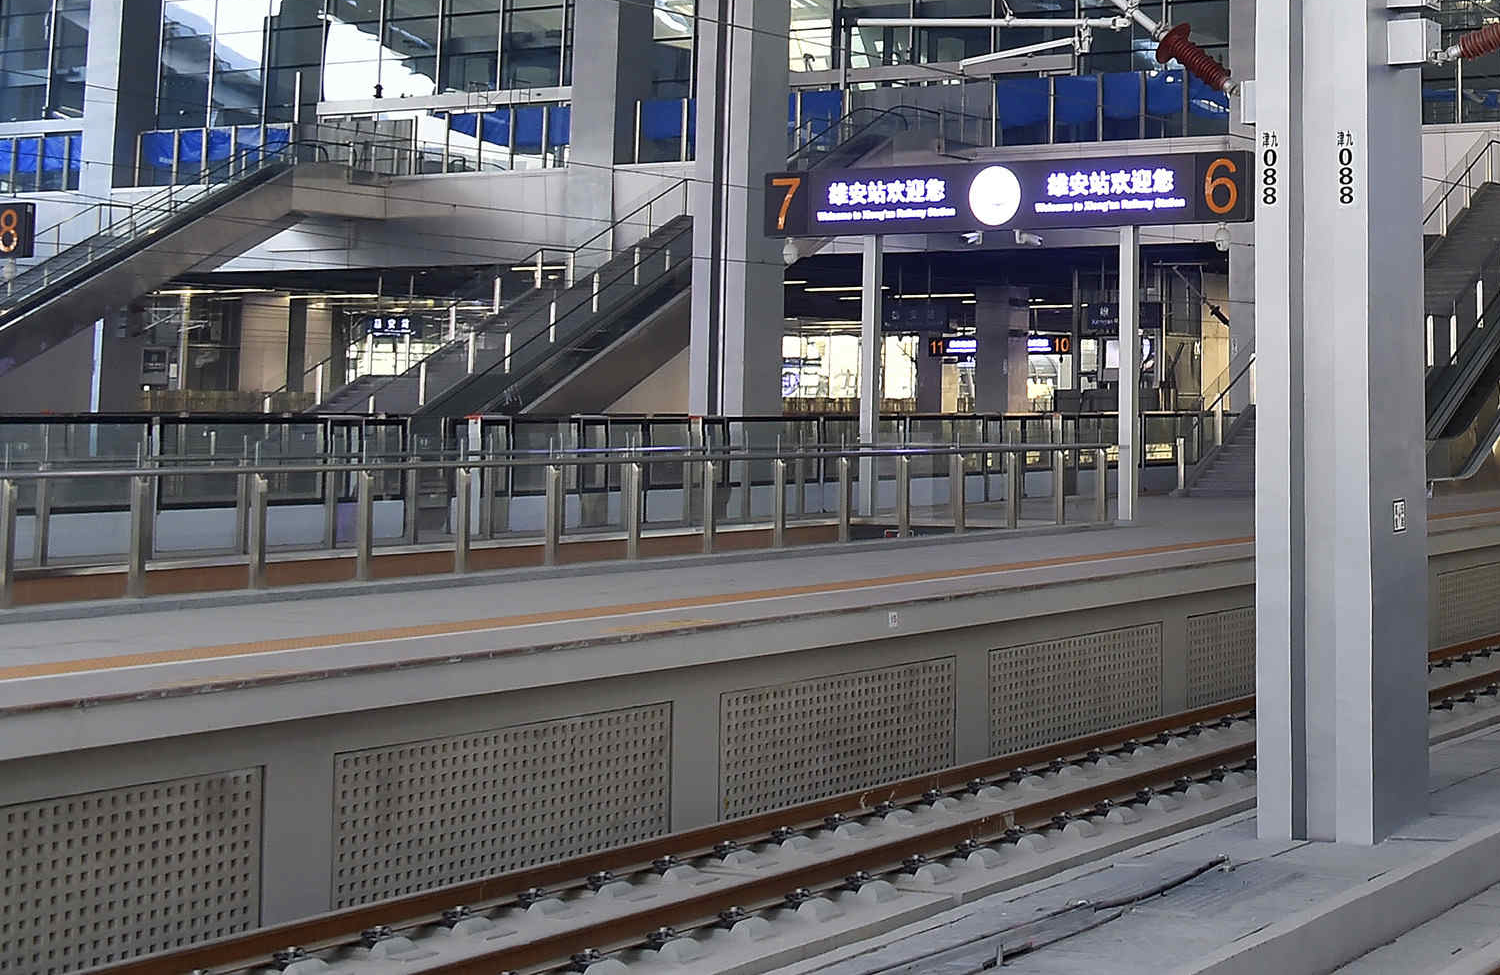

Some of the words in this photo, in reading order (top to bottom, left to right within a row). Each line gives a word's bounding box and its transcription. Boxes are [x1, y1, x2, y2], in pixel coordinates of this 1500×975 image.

[828, 178, 946, 206] 雄安站欢迎您
[1047, 168, 1174, 197] 雄安站欢迎您
[1204, 158, 1238, 215] 6
[1262, 149, 1277, 204] 088
[1338, 148, 1354, 204] 088
[772, 178, 800, 230] 7
[0, 209, 17, 252] 8
[930, 340, 943, 354] 11
[1054, 337, 1070, 353] 10
